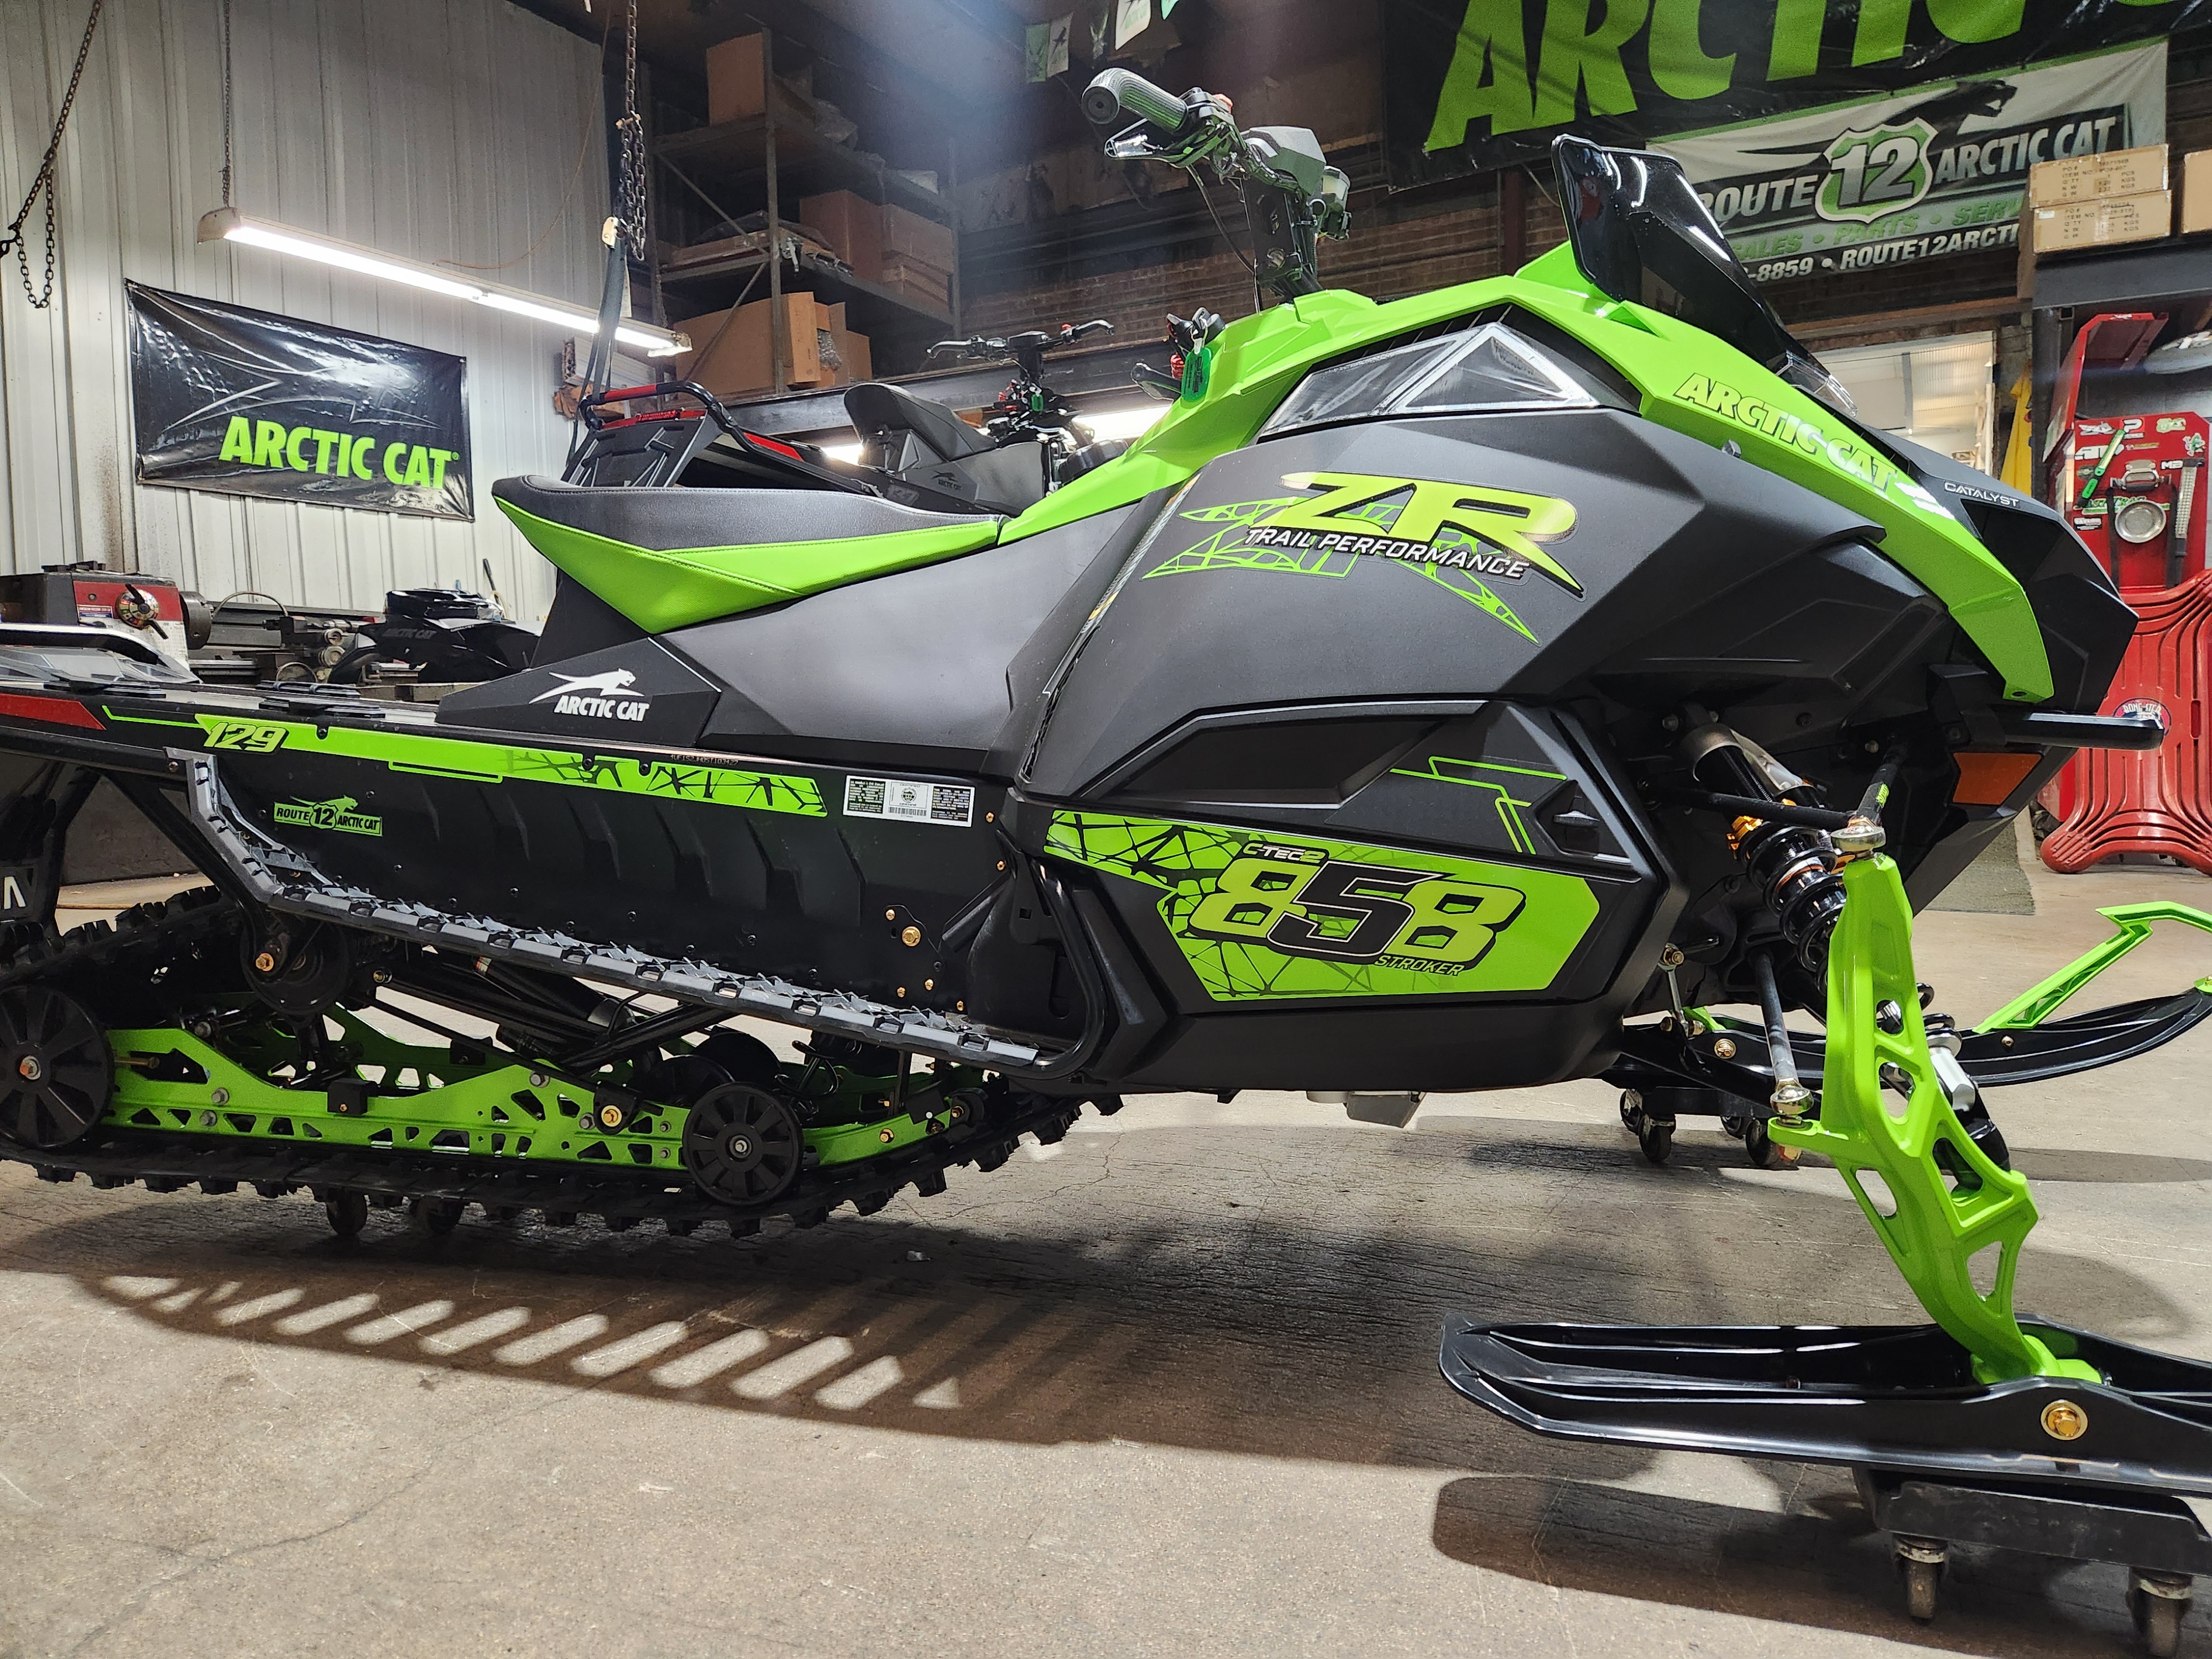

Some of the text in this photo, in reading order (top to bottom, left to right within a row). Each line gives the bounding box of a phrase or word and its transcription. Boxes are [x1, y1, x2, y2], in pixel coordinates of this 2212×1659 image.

[1831, 137, 1918, 207] 12
[1936, 128, 2048, 184] ARCTIC
[2053, 116, 2116, 160] CAT
[1952, 198, 2022, 226] SERV
[1743, 223, 2020, 281] -8859 ROUTE12ARCTI
[218, 416, 375, 480] ARCTIC
[1673, 373, 1897, 492] ARCTIC CAT
[1944, 482, 2019, 507] CATALYST
[1246, 529, 1530, 578] TRAIL PERFORMANCE
[1250, 472, 1583, 595] ZR
[554, 695, 650, 721] ARCTIC CAT
[204, 722, 288, 753] 129
[276, 807, 380, 830] ROUTE 12 ARCTIC CAT
[1243, 843, 1326, 864] C-TEC2
[1190, 858, 1525, 964] 858
[1374, 954, 1465, 976] STROKER
